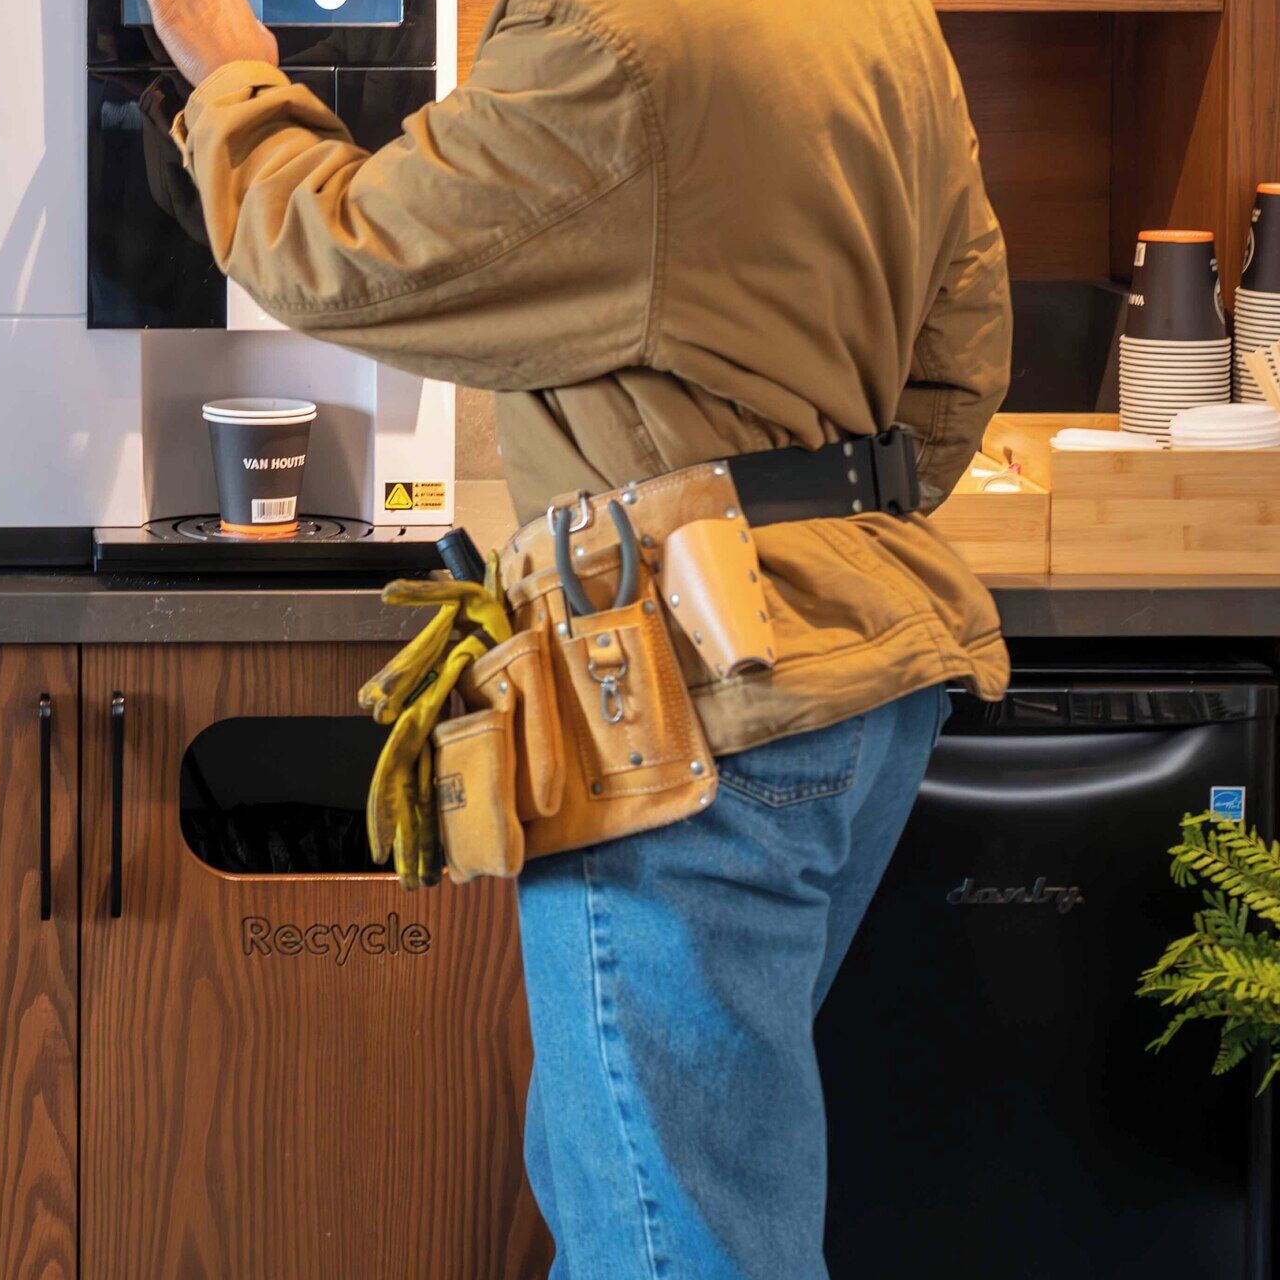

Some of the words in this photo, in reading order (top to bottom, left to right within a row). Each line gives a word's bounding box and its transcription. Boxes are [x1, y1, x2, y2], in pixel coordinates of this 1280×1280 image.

[243, 457, 268, 470] VAN
[270, 454, 306, 470] HOUTTE
[241, 911, 432, 967] Recycle
